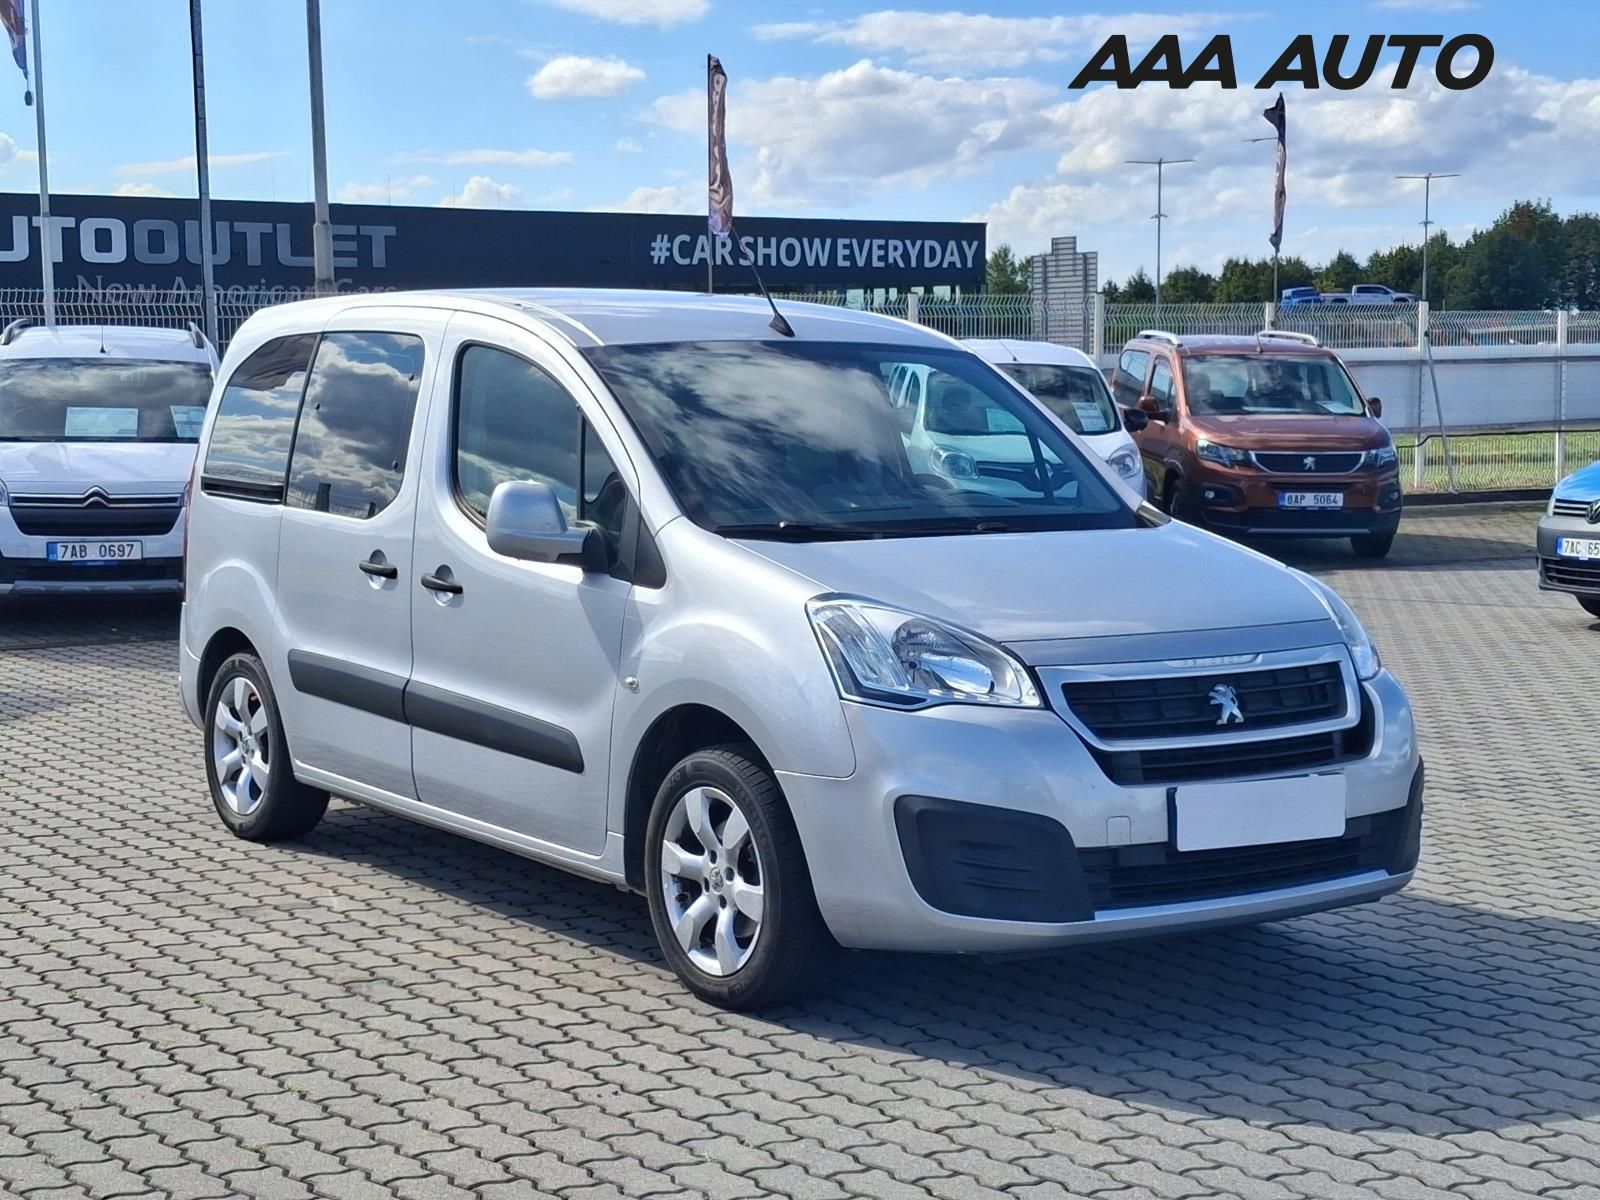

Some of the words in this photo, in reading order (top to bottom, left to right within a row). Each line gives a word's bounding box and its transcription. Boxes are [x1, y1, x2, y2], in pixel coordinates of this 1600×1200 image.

[1313, 494, 1339, 505] 5064
[60, 544, 88, 559] 7AB
[99, 543, 135, 558] 0697
[1564, 540, 1581, 555] 7AC
